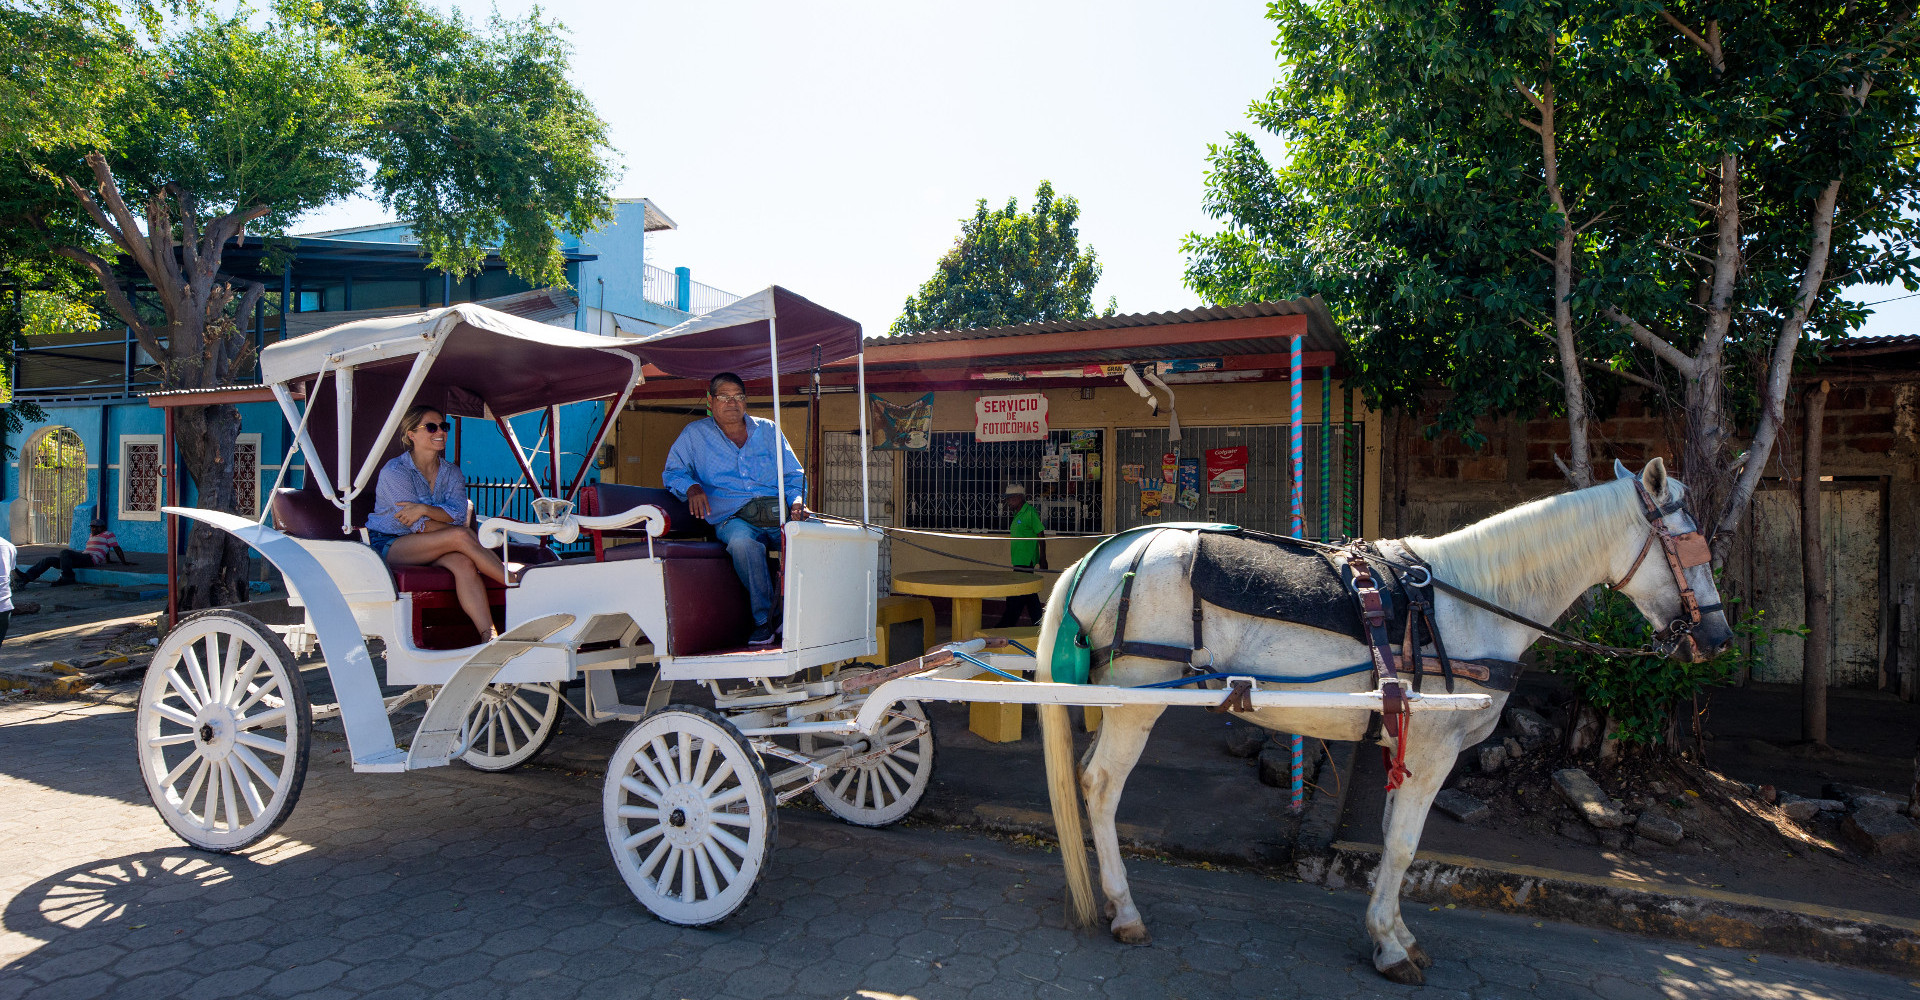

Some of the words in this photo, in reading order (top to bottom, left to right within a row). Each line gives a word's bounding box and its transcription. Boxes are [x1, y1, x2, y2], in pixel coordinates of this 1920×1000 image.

[984, 399, 1038, 413] SERVICIO
[1006, 412, 1017, 421] DE
[982, 421, 1039, 435] FOTOCOPIAS
